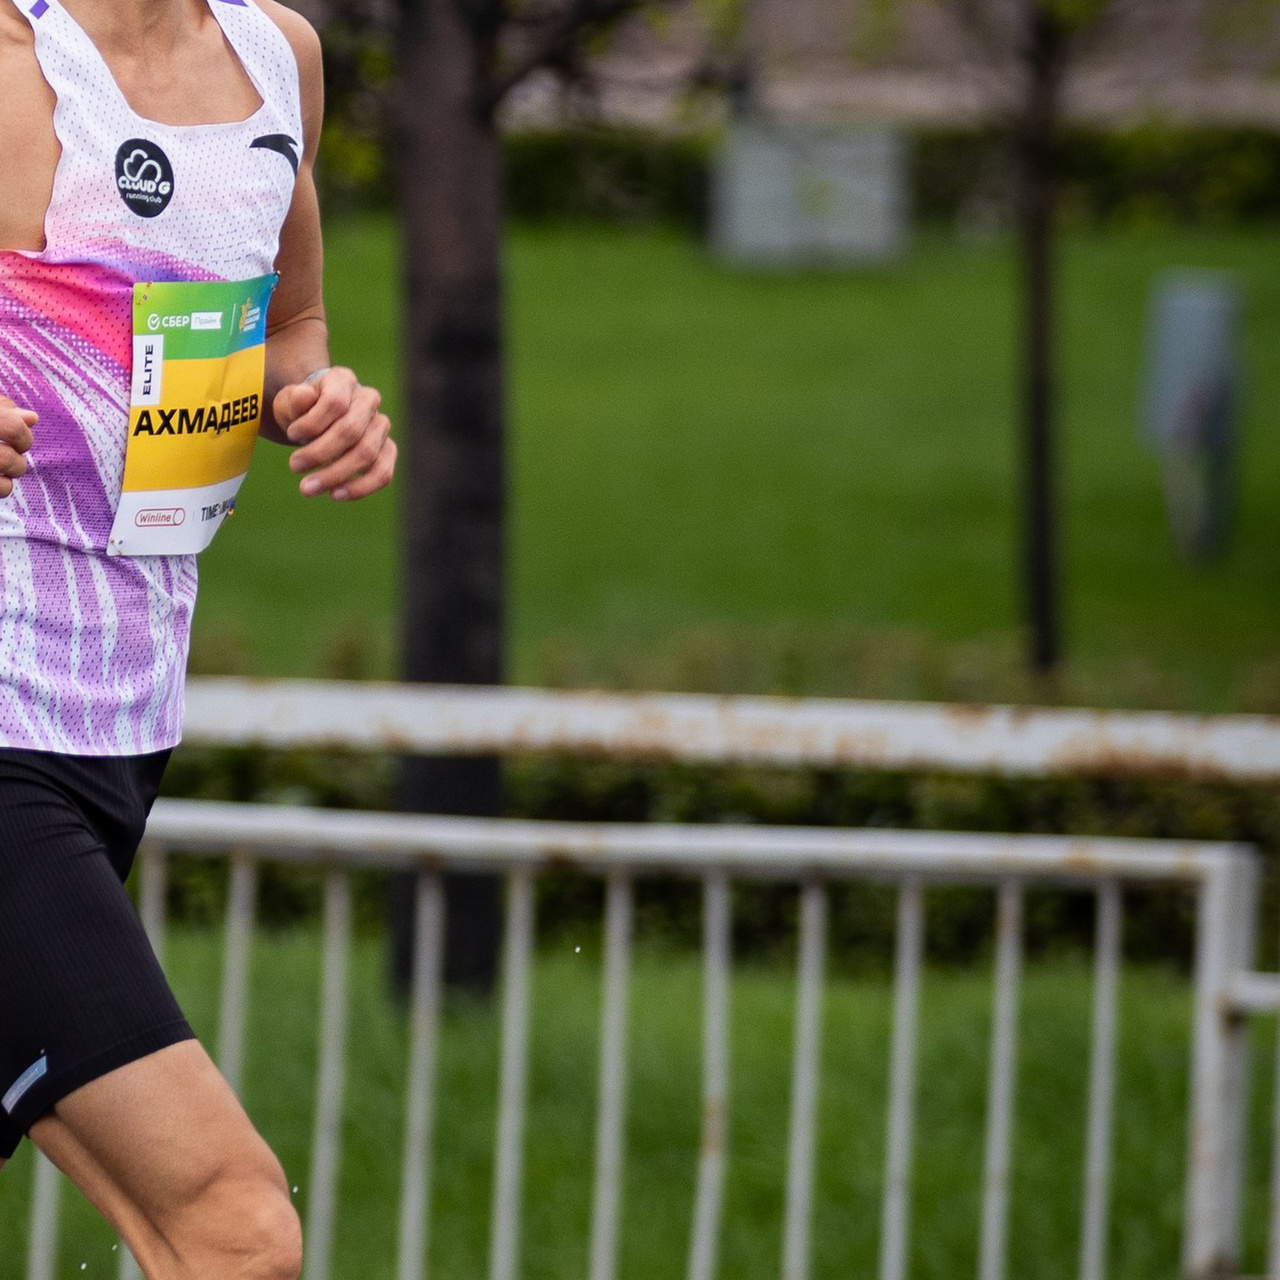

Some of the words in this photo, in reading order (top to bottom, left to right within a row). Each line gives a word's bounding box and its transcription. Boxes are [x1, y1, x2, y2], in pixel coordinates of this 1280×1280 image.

[158, 181, 171, 195] G
[162, 315, 190, 327] СБЕР
[142, 344, 154, 396] ELITE
[133, 393, 259, 436] АХМАДЕЕВ
